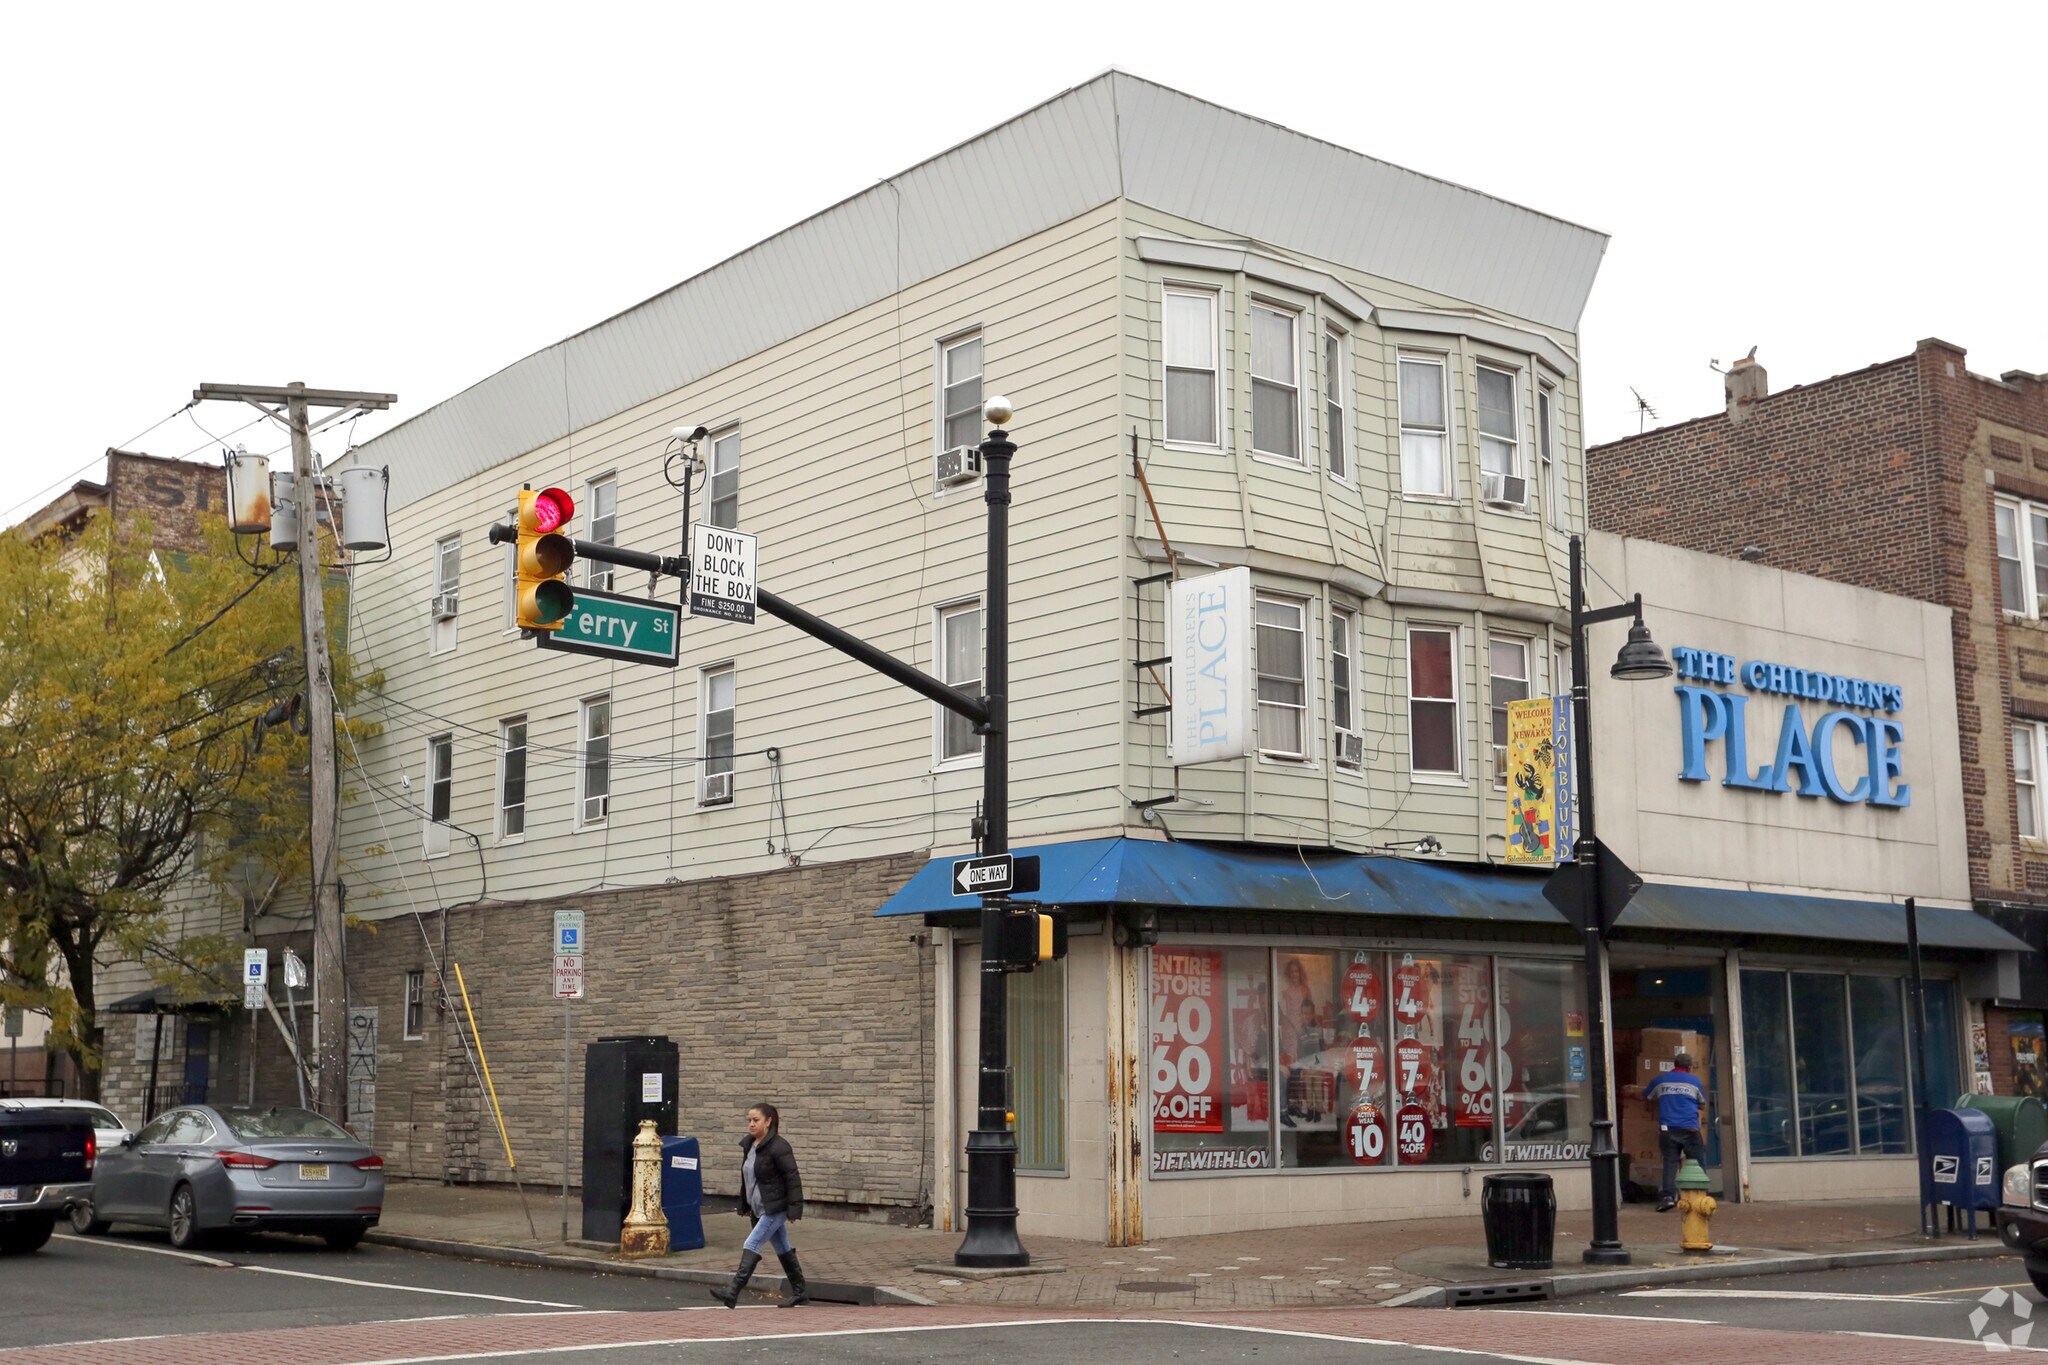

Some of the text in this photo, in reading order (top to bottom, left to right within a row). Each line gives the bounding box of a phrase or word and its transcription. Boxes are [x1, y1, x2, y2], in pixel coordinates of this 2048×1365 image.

[707, 533, 743, 555] DON'T
[704, 554, 744, 578] BLOCK
[696, 574, 752, 601] THE BOX
[693, 606, 721, 615] ORDINANCE
[701, 597, 745, 613] FINE $250.00
[653, 618, 668, 634] St
[1185, 592, 1197, 706] CHILDREN'S
[1198, 585, 1228, 750] PLACE
[1672, 647, 1904, 712] THE CHILDREN'S
[1515, 707, 1551, 719] WELCOME
[1543, 718, 1551, 726] TO
[1187, 716, 1197, 752] THE
[1514, 728, 1551, 739] NEWARK'S
[1674, 685, 1911, 808] PLACE
[1557, 698, 1571, 859] IRONBOUND
[970, 866, 1006, 883] ONE WAY
[563, 959, 574, 967] NO
[1153, 954, 1211, 976] ENTIRE
[1153, 974, 1211, 996] STORE
[1459, 985, 1510, 1004] STOE
[1153, 995, 1211, 1045] 40
[1458, 1004, 1512, 1047] 40
[1153, 1045, 1211, 1094] 60
[1461, 1048, 1513, 1092] 60
[1153, 1094, 1212, 1118] %OFF
[1462, 1093, 1514, 1114] %OF
[1351, 1124, 1384, 1158] $10
[1400, 1122, 1425, 1143] 40
[1401, 1143, 1425, 1153] %OFF
[1517, 1144, 1553, 1161] WITH
[1190, 1151, 1238, 1169] WITH
[1238, 1150, 1282, 1168] LOV
